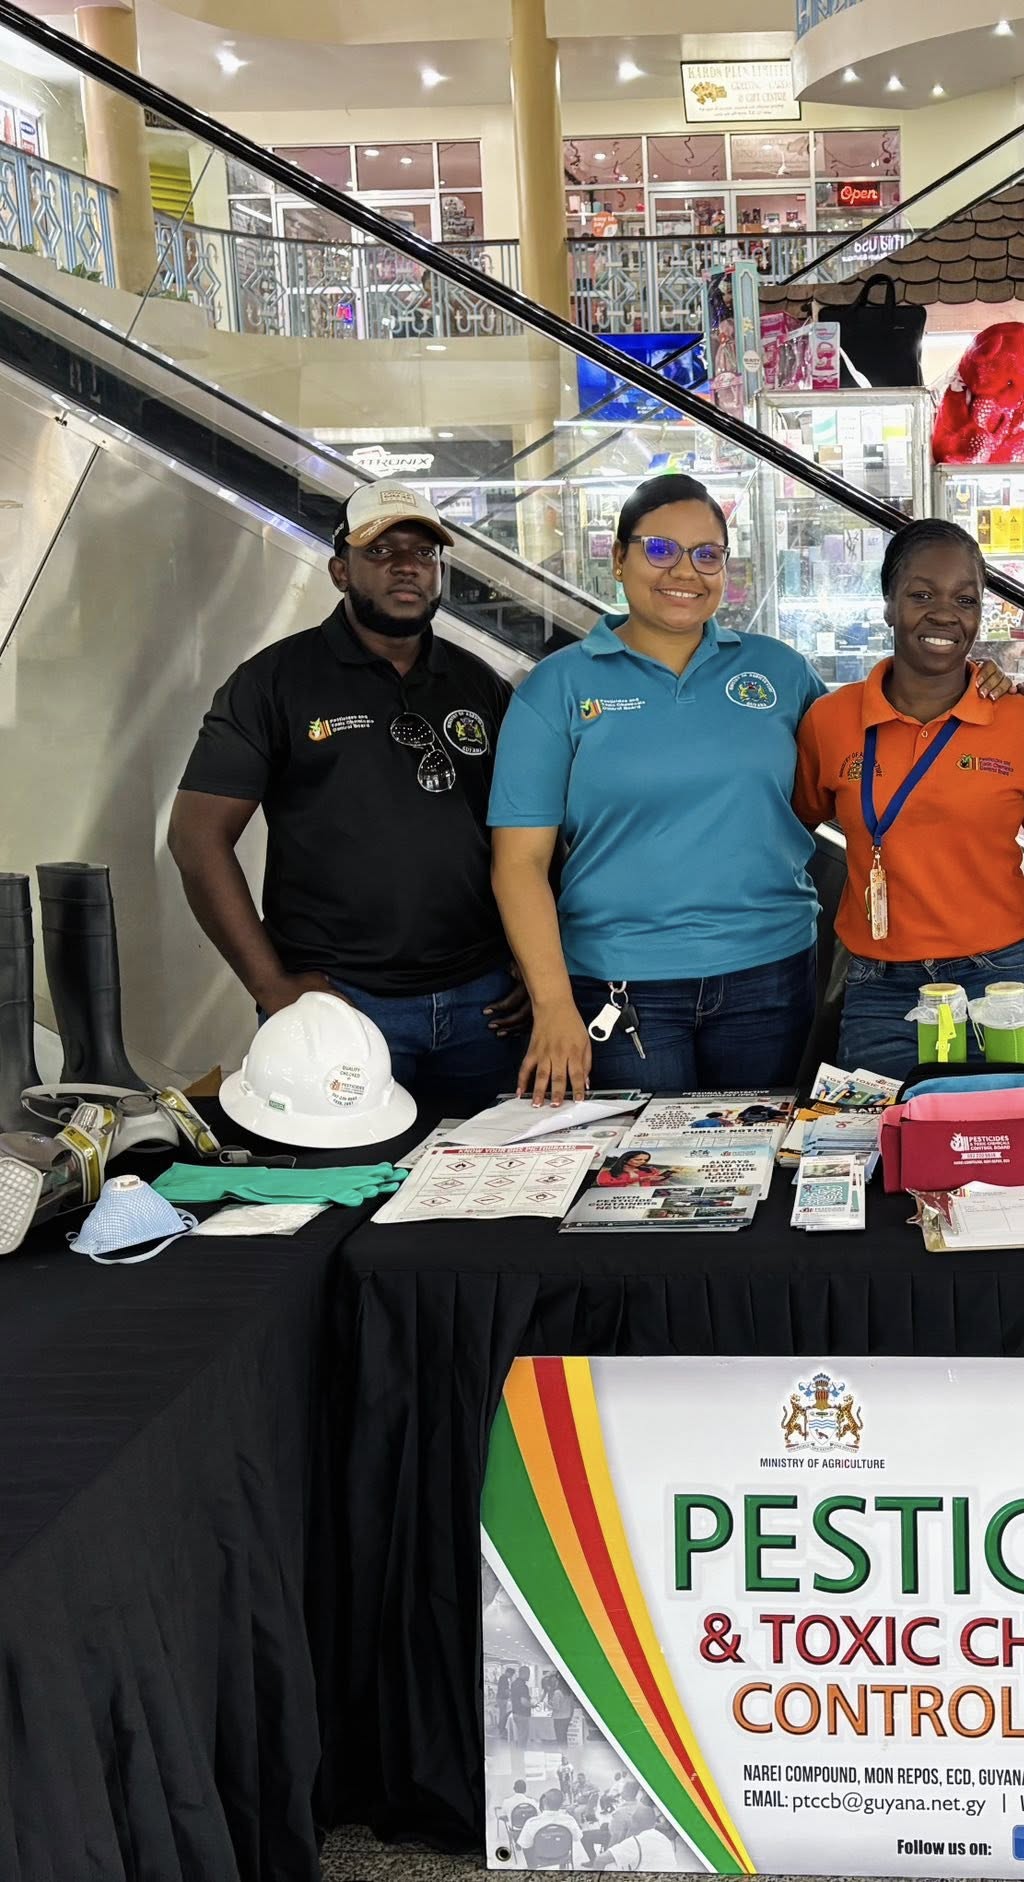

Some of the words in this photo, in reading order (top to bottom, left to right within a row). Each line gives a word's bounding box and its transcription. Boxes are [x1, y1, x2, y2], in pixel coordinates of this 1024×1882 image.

[840, 185, 878, 205] Open
[760, 1458, 804, 1468] MINISTRY
[807, 1458, 819, 1468] OF
[822, 1459, 885, 1469] AGRICULTURE
[699, 1613, 742, 1664] &
[760, 1614, 940, 1665] TOXIC
[744, 1765, 781, 1781] NAREI
[785, 1766, 860, 1784] COMPOUND,
[864, 1767, 893, 1784] MON
[897, 1768, 942, 1786] REPOS,
[946, 1768, 975, 1786] ECD,
[744, 1790, 788, 1807] EMAIL:
[793, 1792, 986, 1816] ptccb@guyana.net.gy
[897, 1839, 945, 1855] Follow
[948, 1843, 966, 1855] us
[969, 1843, 992, 1855] on:
